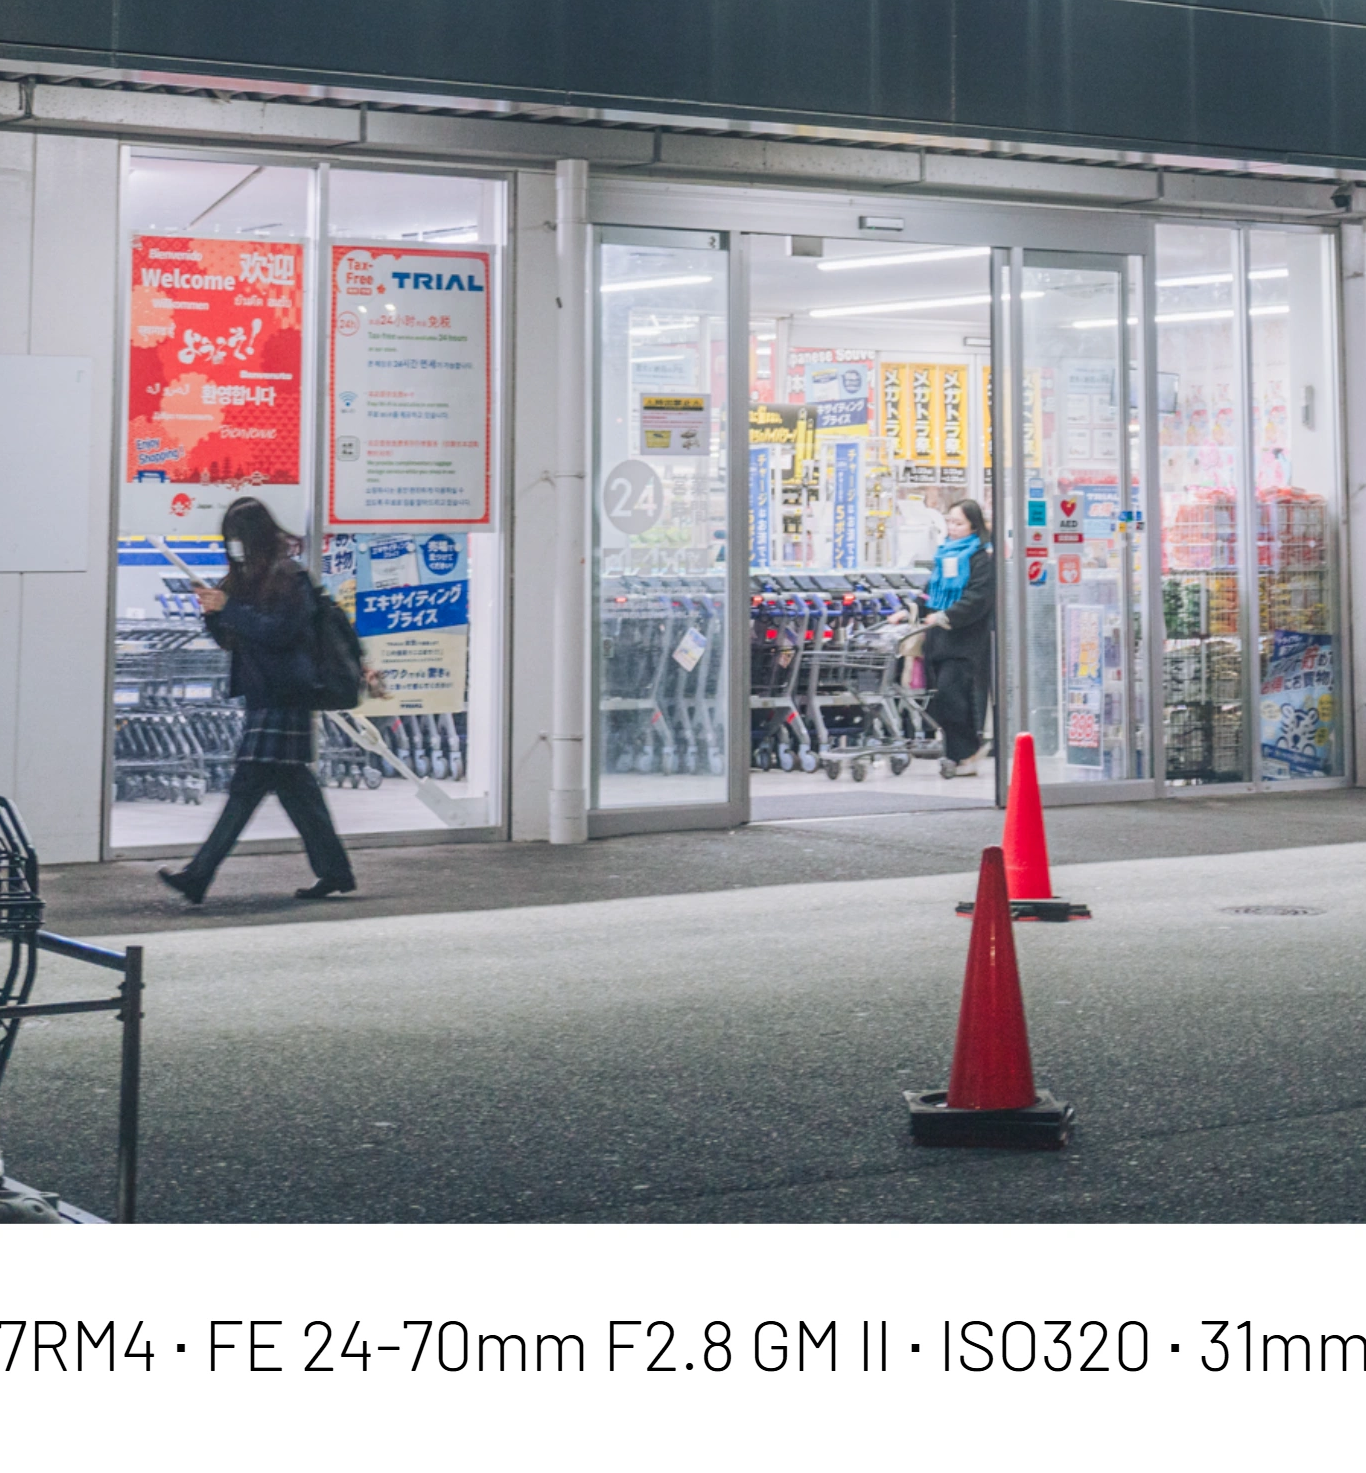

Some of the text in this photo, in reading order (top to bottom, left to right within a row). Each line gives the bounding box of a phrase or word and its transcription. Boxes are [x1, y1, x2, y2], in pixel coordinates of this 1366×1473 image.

[141, 267, 236, 291] Welcome
[239, 252, 295, 286] 欢迎
[346, 272, 374, 286] Free
[392, 271, 484, 292] TRIAL
[201, 384, 276, 407] 환영합니다
[136, 438, 161, 451] Enjoy
[609, 476, 657, 517] 24
[1060, 520, 1078, 528] AED
[363, 584, 462, 613] エキサイティング
[387, 609, 439, 629] プライス
